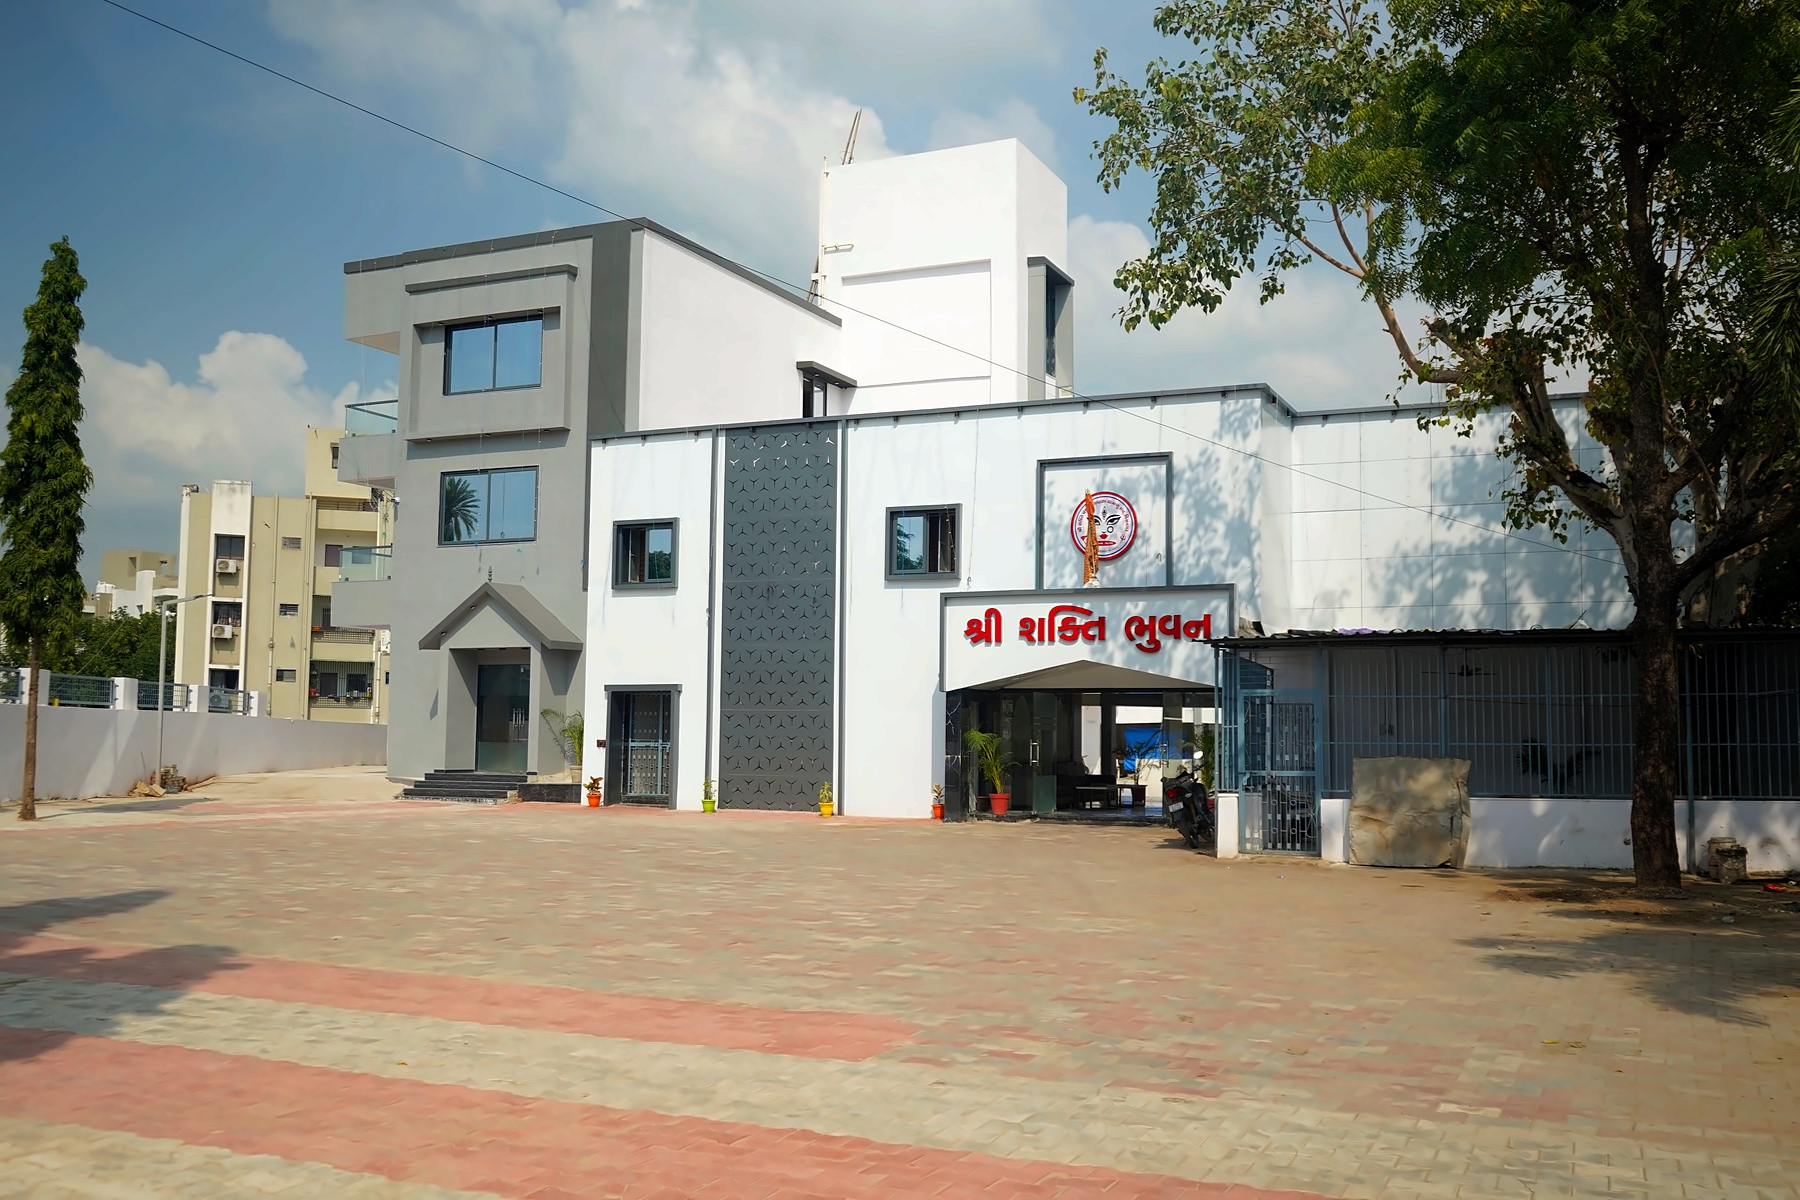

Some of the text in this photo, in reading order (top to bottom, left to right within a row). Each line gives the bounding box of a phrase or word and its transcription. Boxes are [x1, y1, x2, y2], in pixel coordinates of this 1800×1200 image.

[963, 605, 1211, 654] શ્રી શક્તિ ભુવન
